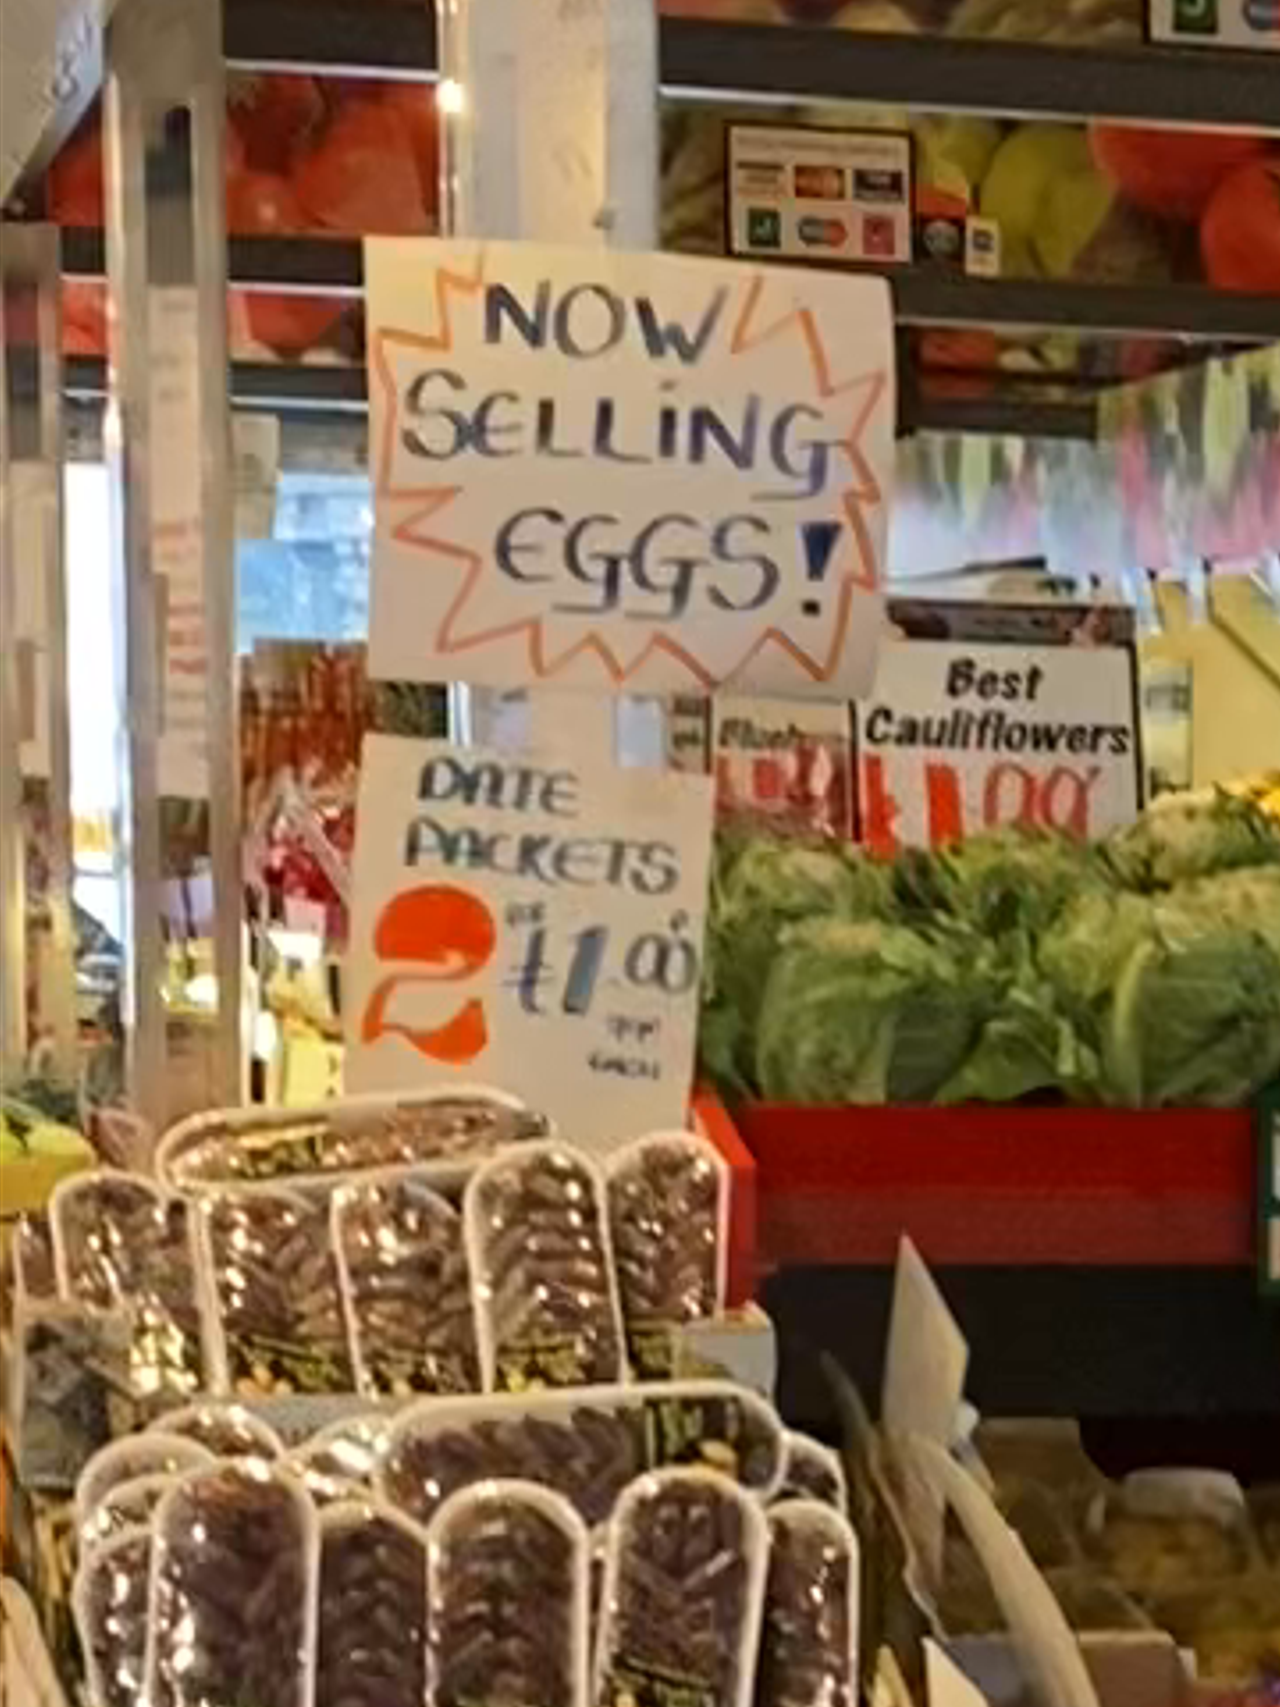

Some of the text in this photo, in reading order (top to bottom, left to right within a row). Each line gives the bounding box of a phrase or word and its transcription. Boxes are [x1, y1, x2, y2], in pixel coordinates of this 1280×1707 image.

[482, 279, 730, 367] NOW
[401, 367, 830, 501] SELLING
[494, 507, 844, 618] EGGS!
[946, 657, 1045, 701] Best
[864, 705, 1131, 757] Cauliflowers
[416, 755, 580, 818] DATE
[404, 816, 680, 895] PACKETS
[362, 883, 496, 1064] 2
